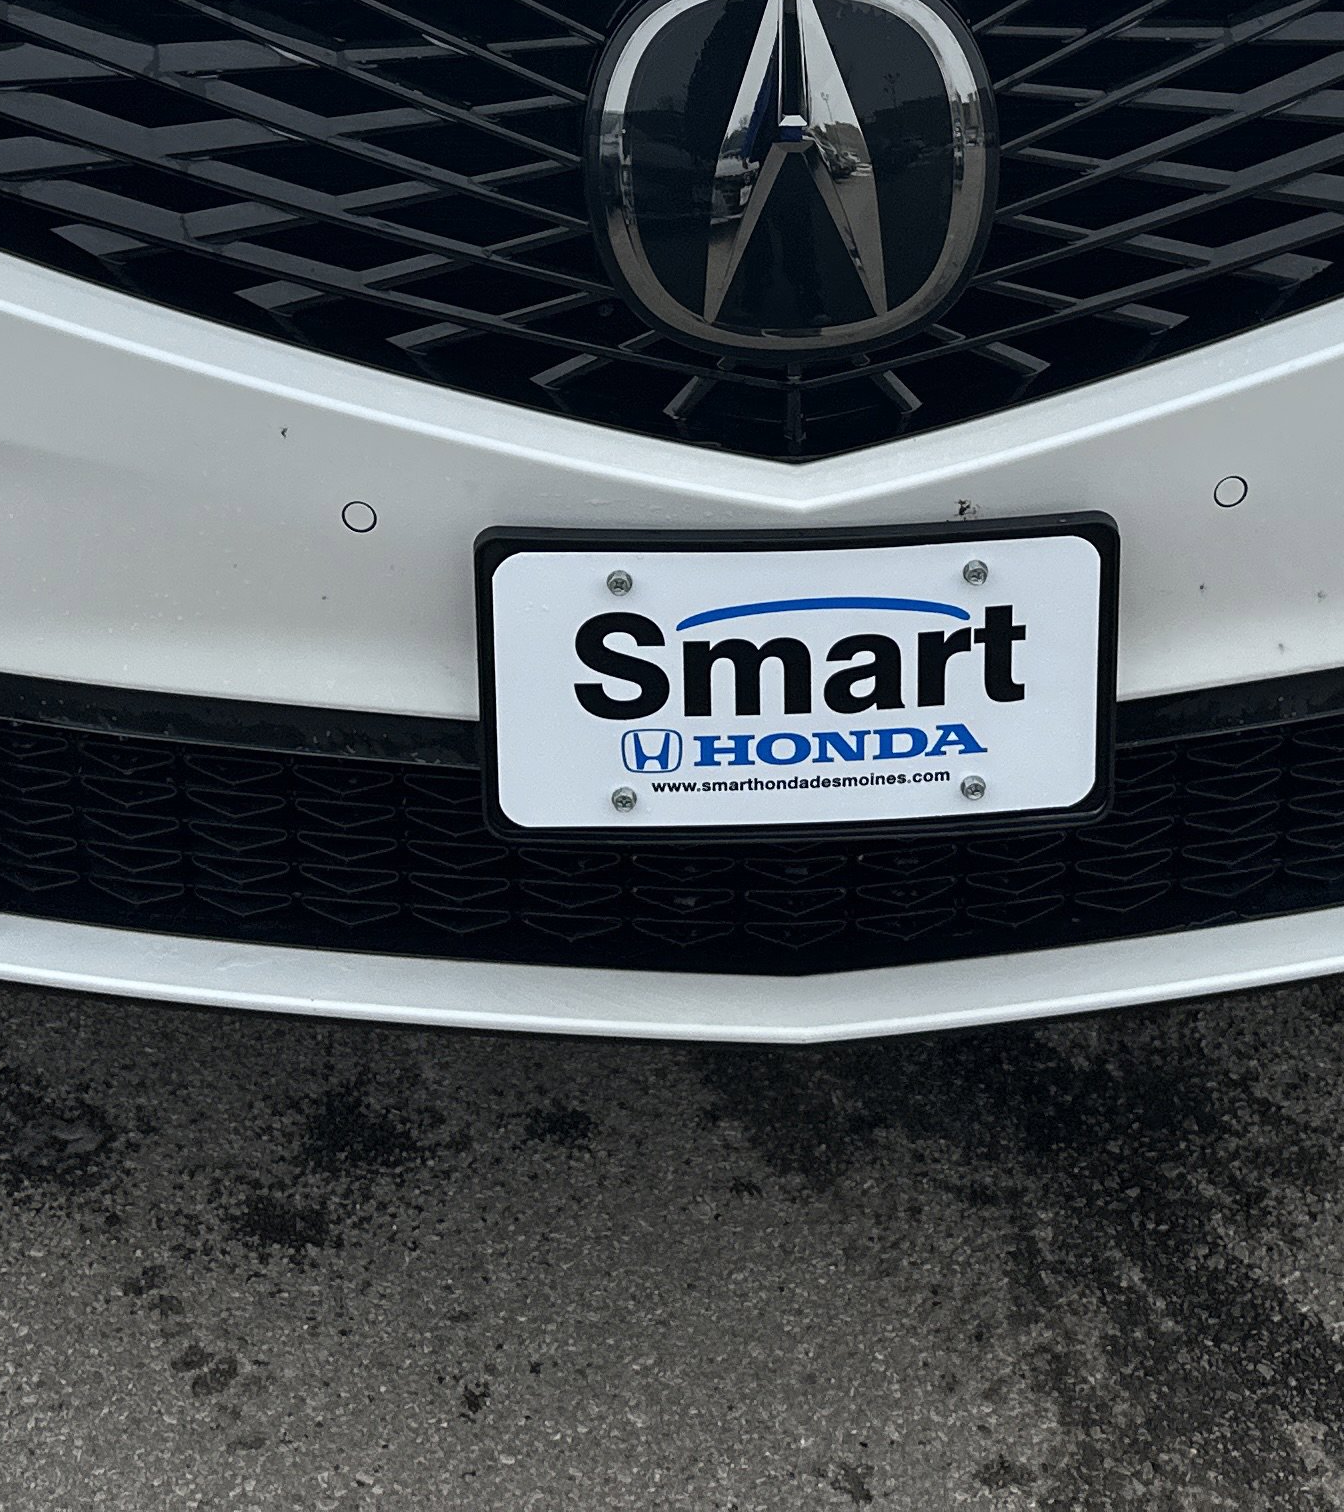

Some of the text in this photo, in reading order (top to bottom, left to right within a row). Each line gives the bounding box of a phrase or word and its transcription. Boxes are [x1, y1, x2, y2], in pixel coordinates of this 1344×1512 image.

[573, 604, 1027, 721] Smart
[693, 723, 988, 767] HONDA
[651, 769, 951, 794] www.smarthondadesmoines.com
